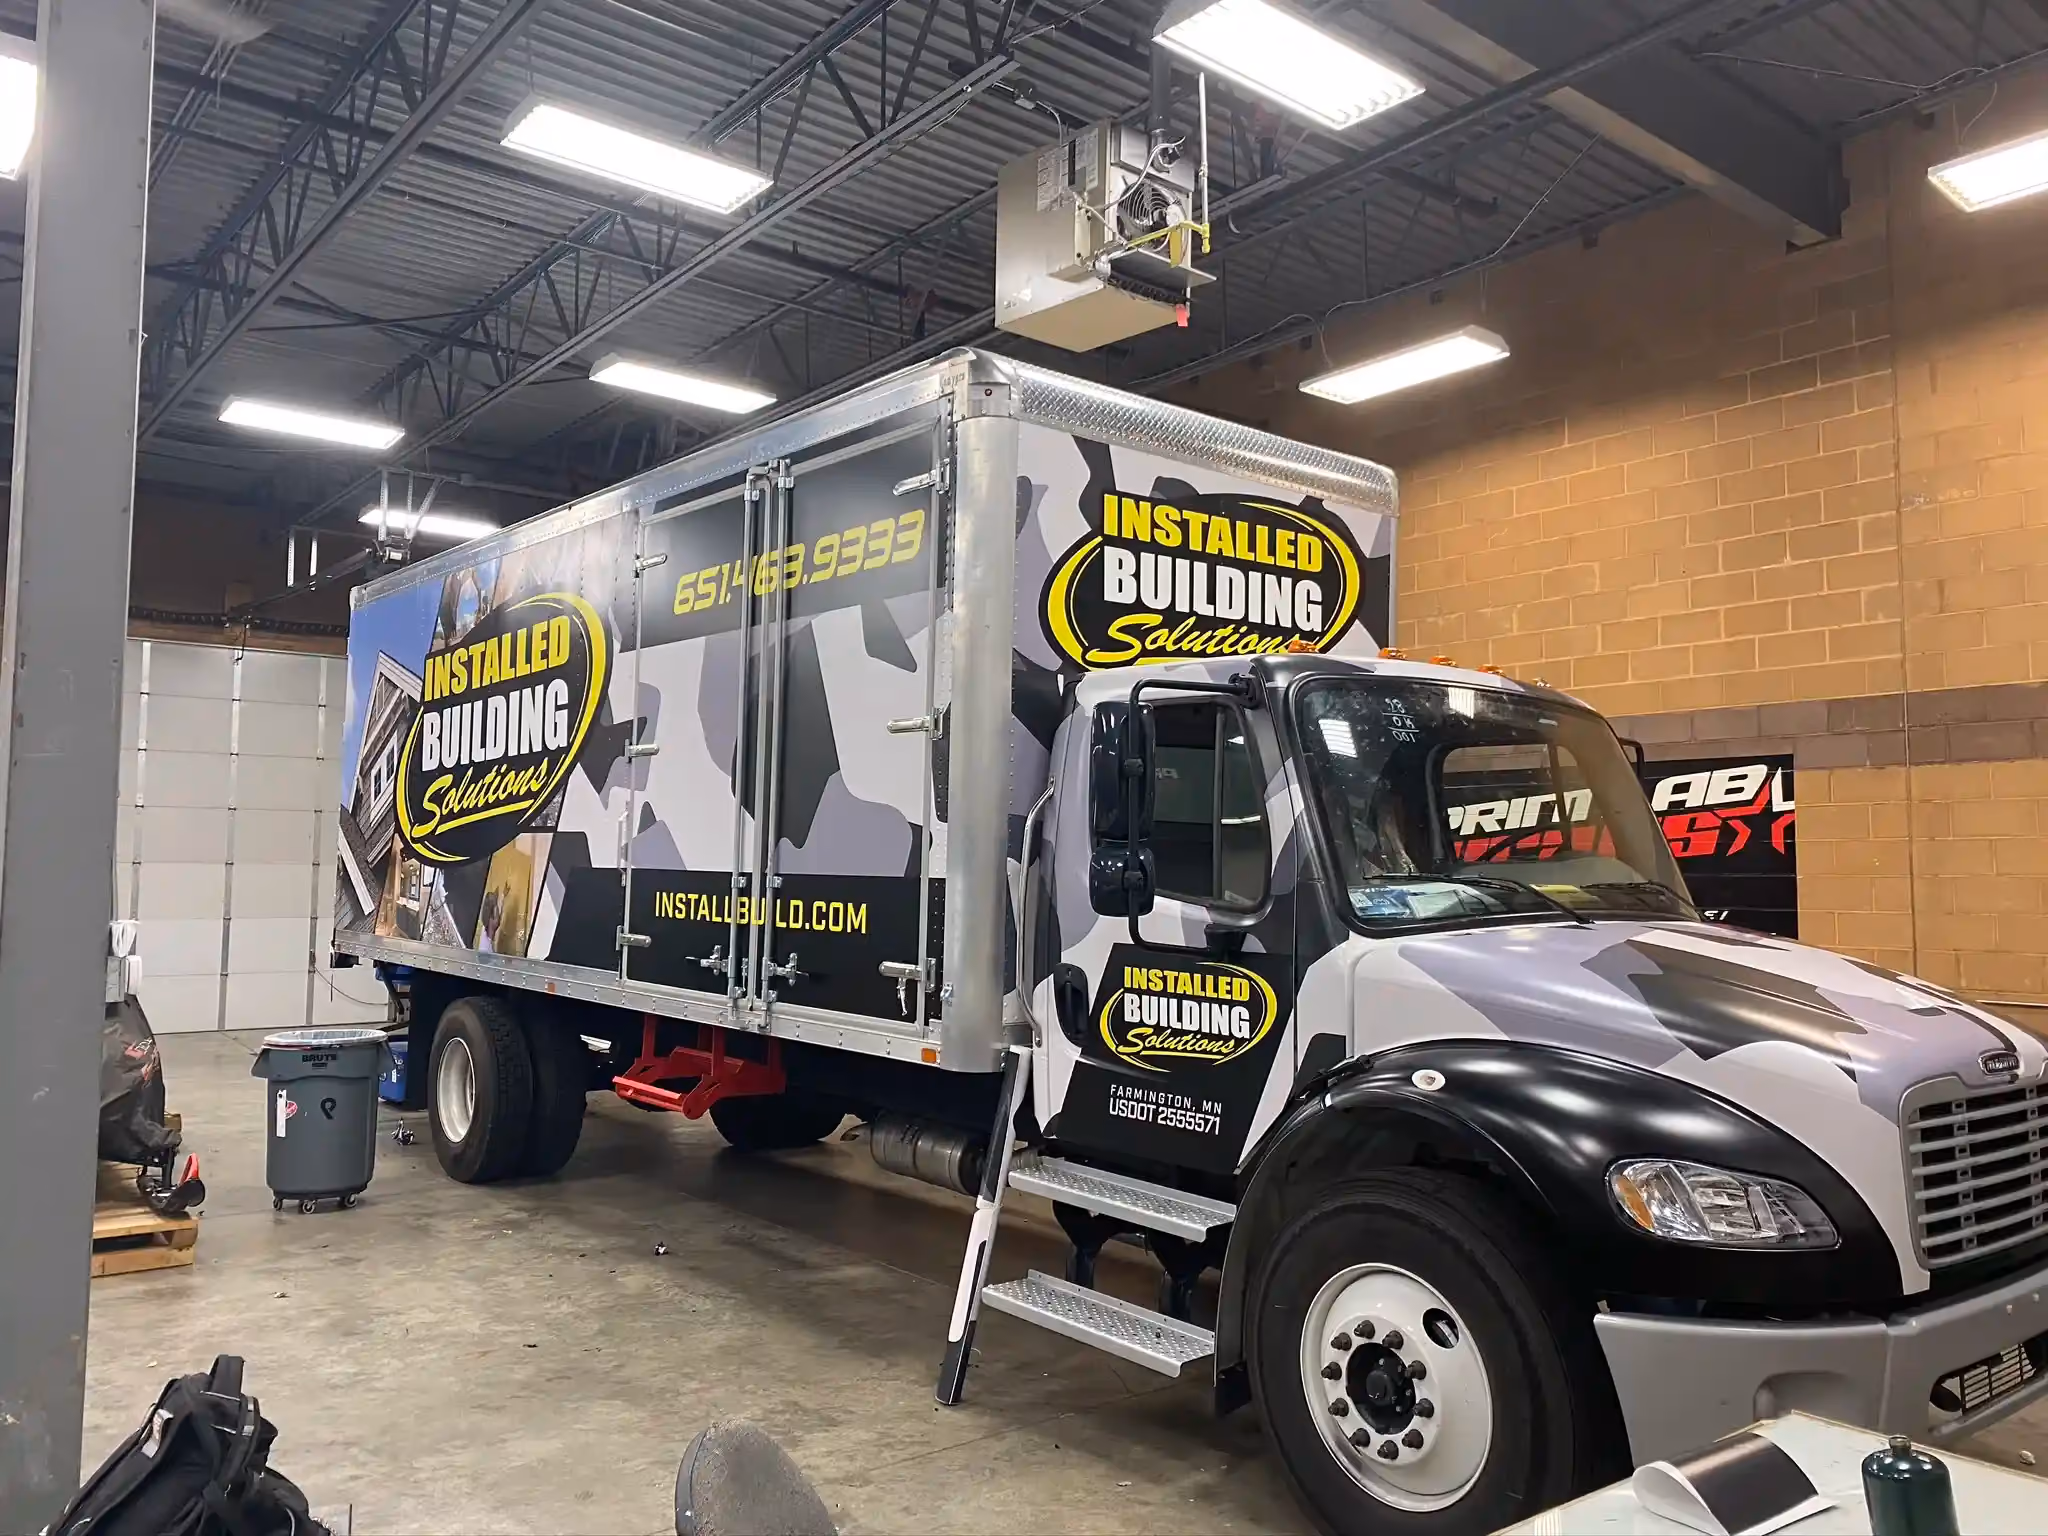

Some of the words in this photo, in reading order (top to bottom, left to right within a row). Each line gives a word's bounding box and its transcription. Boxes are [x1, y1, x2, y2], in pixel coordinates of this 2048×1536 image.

[673, 508, 926, 616] 651.463.9333
[1103, 493, 1323, 573] INSTALLED
[1103, 545, 1323, 633] BUILDING
[424, 615, 570, 702] INSTALLED
[421, 678, 569, 772] BUILDING
[410, 756, 549, 838] Solutions
[655, 891, 868, 935] INSTALLBULD.COM
[1123, 965, 1250, 1002] INSTALLED
[1116, 1026, 1235, 1054] Solutions
[1123, 992, 1251, 1039] BUILDING
[1109, 1097, 1157, 1122] USDOT
[1157, 1106, 1221, 1136] 2555571
[1110, 1084, 1196, 1112] FARMINGTON,
[1202, 1099, 1222, 1115] MN
